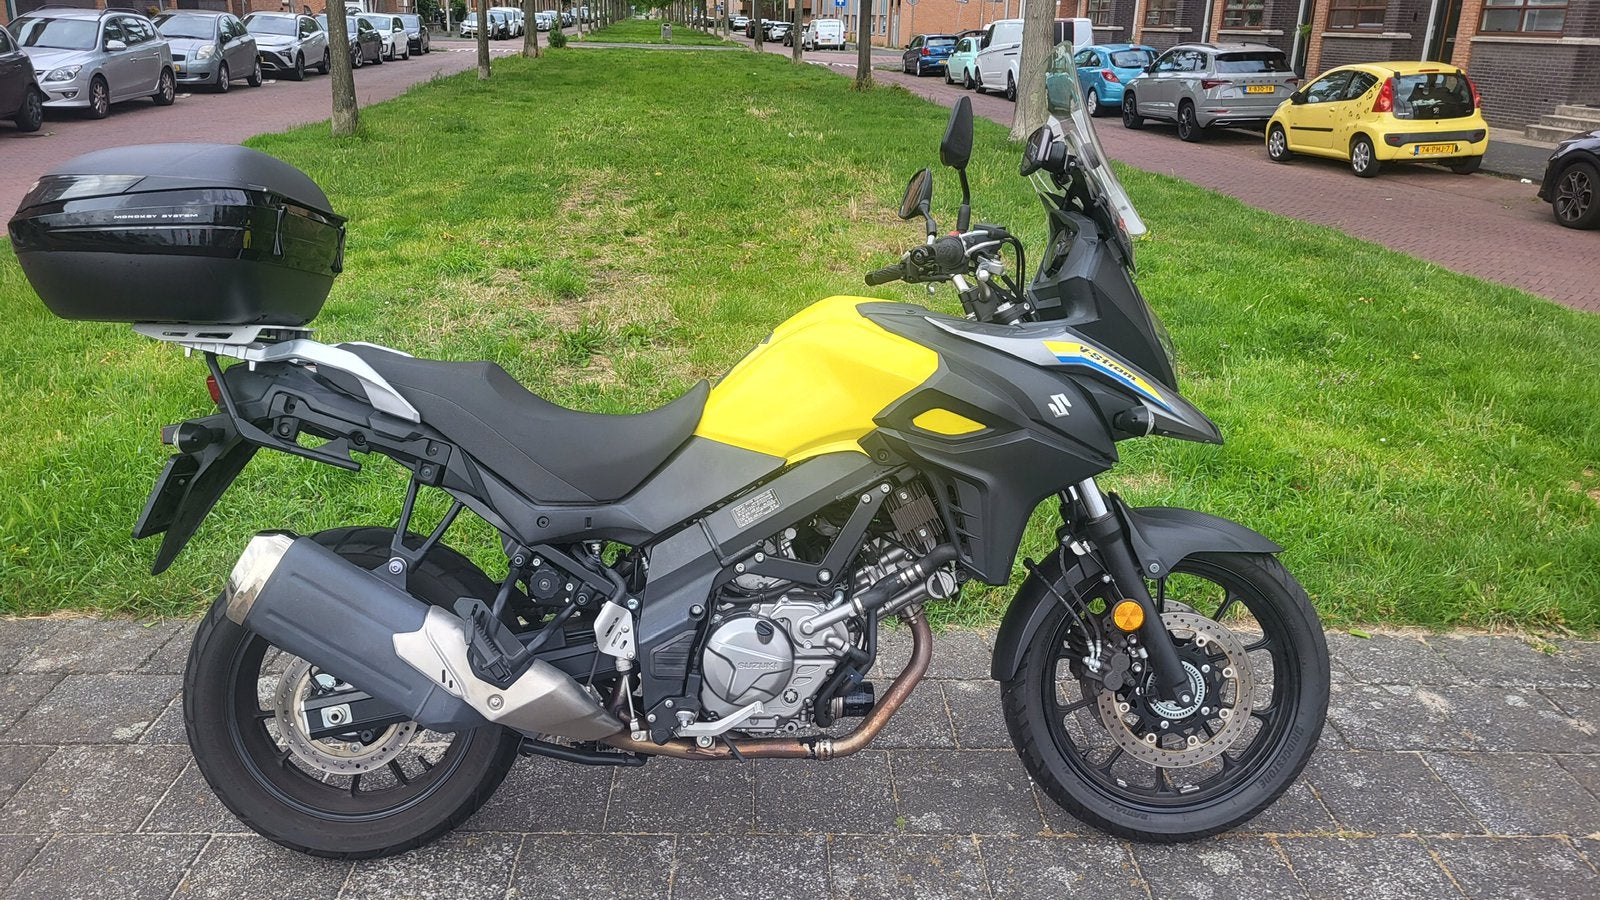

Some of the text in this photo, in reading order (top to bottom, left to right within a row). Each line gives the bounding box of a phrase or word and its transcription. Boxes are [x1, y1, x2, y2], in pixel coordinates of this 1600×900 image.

[1079, 345, 1138, 381] V-Strom
[738, 661, 778, 671] SUZUKI
[1260, 724, 1305, 790] BRIDGESTONE
